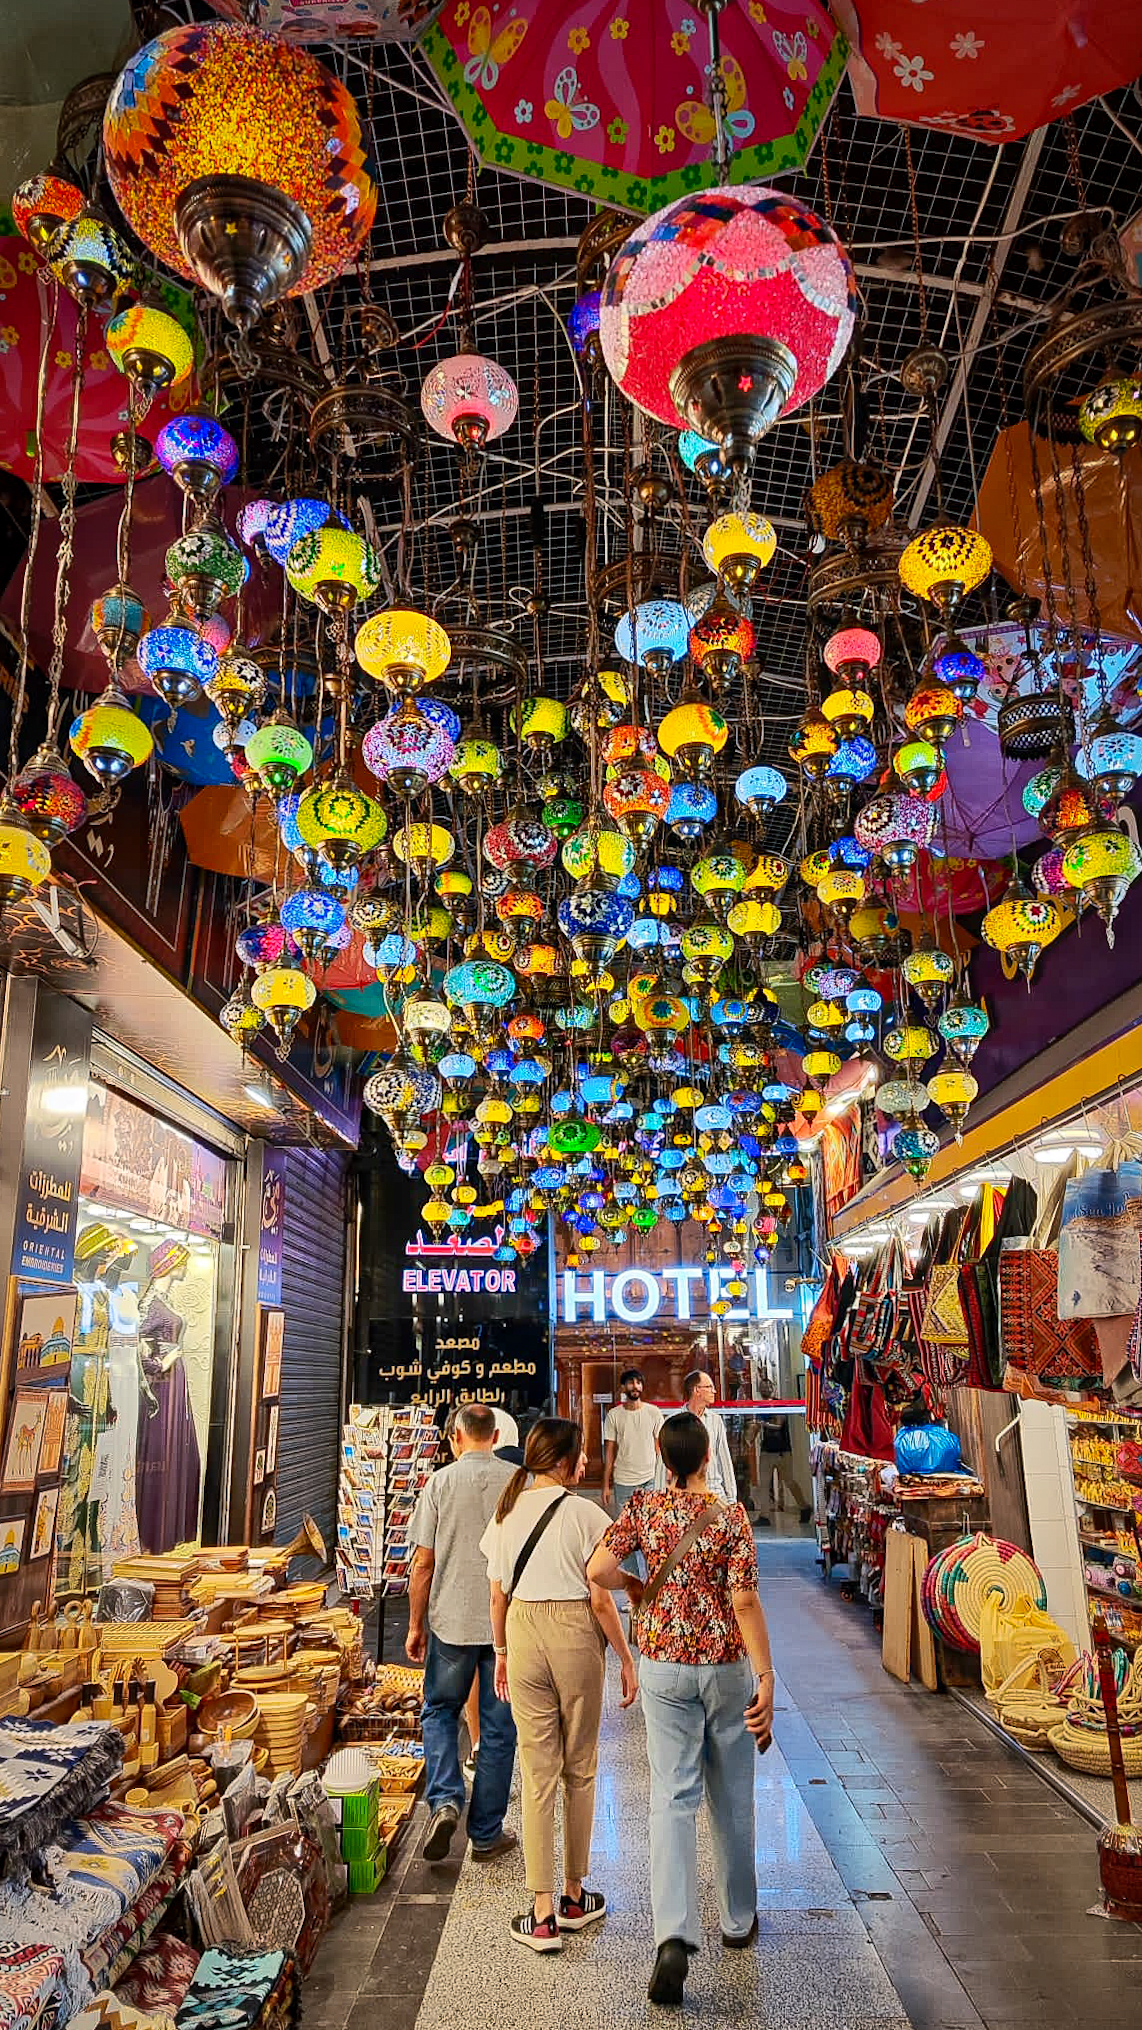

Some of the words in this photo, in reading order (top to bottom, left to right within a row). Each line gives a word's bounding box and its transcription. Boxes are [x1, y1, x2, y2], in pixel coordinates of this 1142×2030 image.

[23, 1240, 65, 1260] ORIENTAL
[402, 1269, 516, 1293] ELEVATOR
[564, 1267, 794, 1322] HOTEL
[435, 1337, 480, 1350] مصعد
[378, 1358, 423, 1381] شوب
[427, 1360, 471, 1384] كوفي
[475, 1363, 485, 1379] و
[489, 1358, 536, 1378] مطعم
